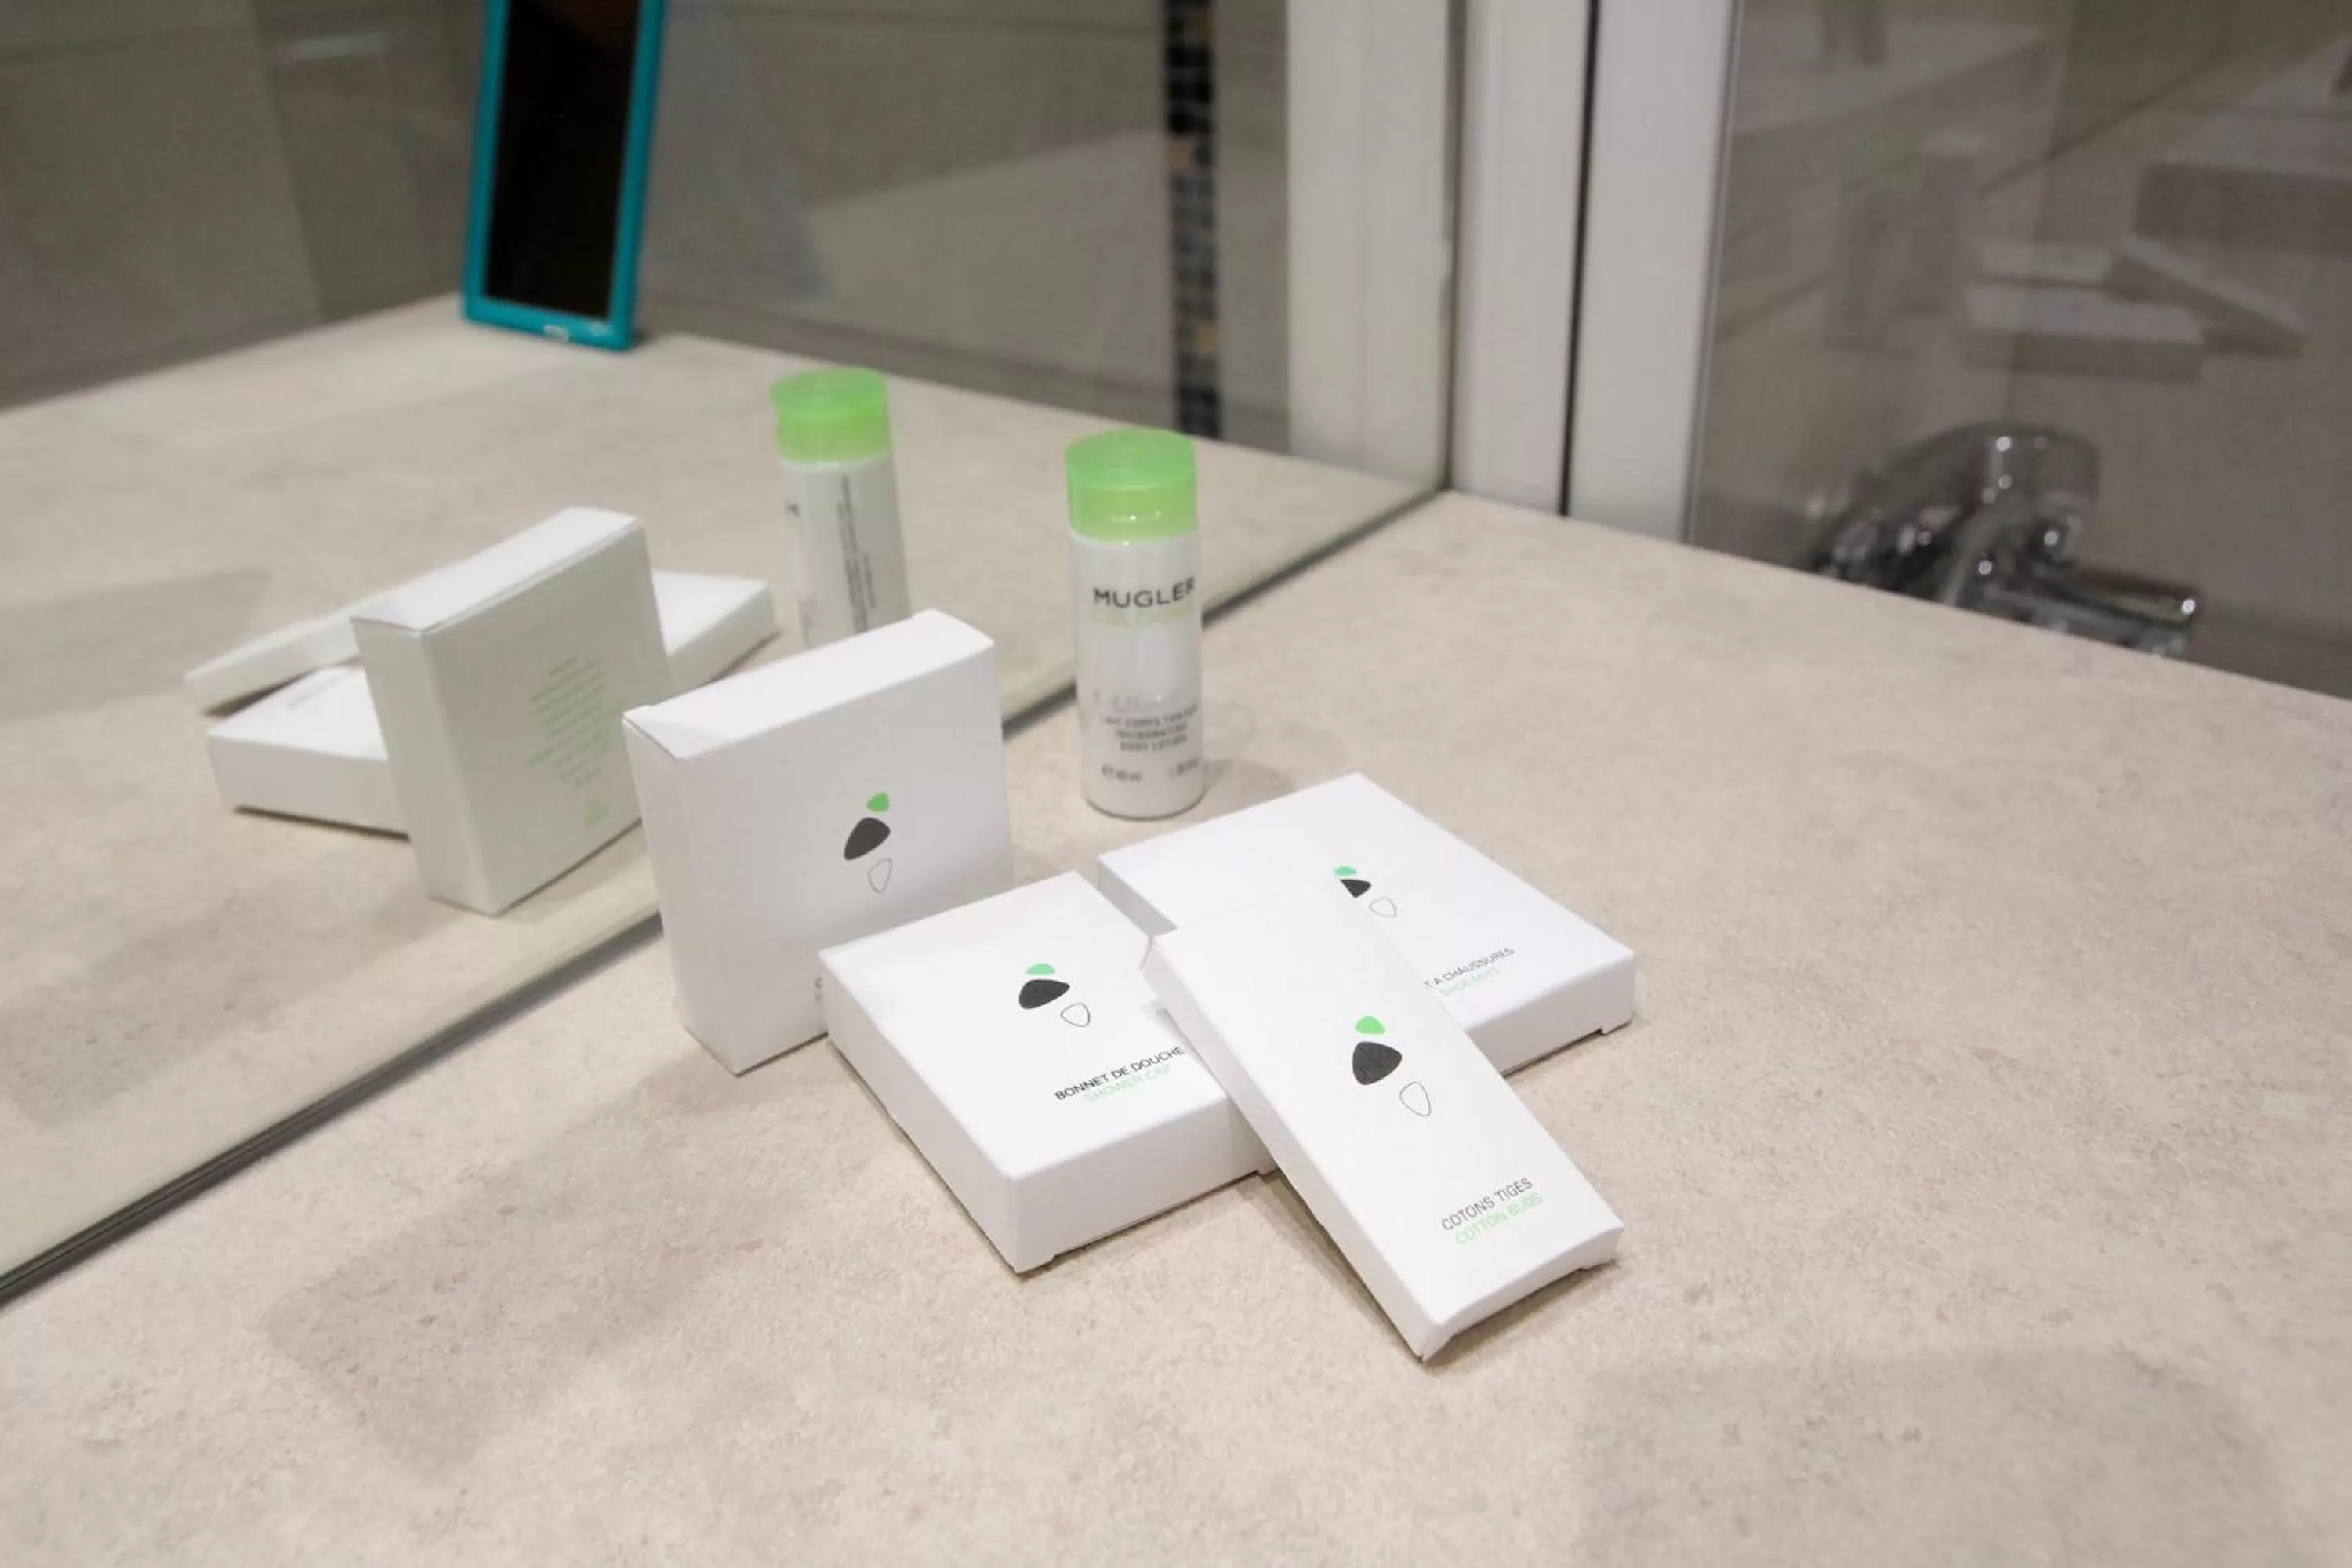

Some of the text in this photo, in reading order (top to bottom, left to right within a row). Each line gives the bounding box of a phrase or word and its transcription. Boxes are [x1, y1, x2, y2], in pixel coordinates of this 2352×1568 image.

[1093, 576, 1196, 608] MUGLER
[1054, 1046, 1185, 1101] BONNET DE DOUCHE
[1441, 1177, 1533, 1231] COTONS TIGES
[1455, 1208, 1508, 1244] COTTON
